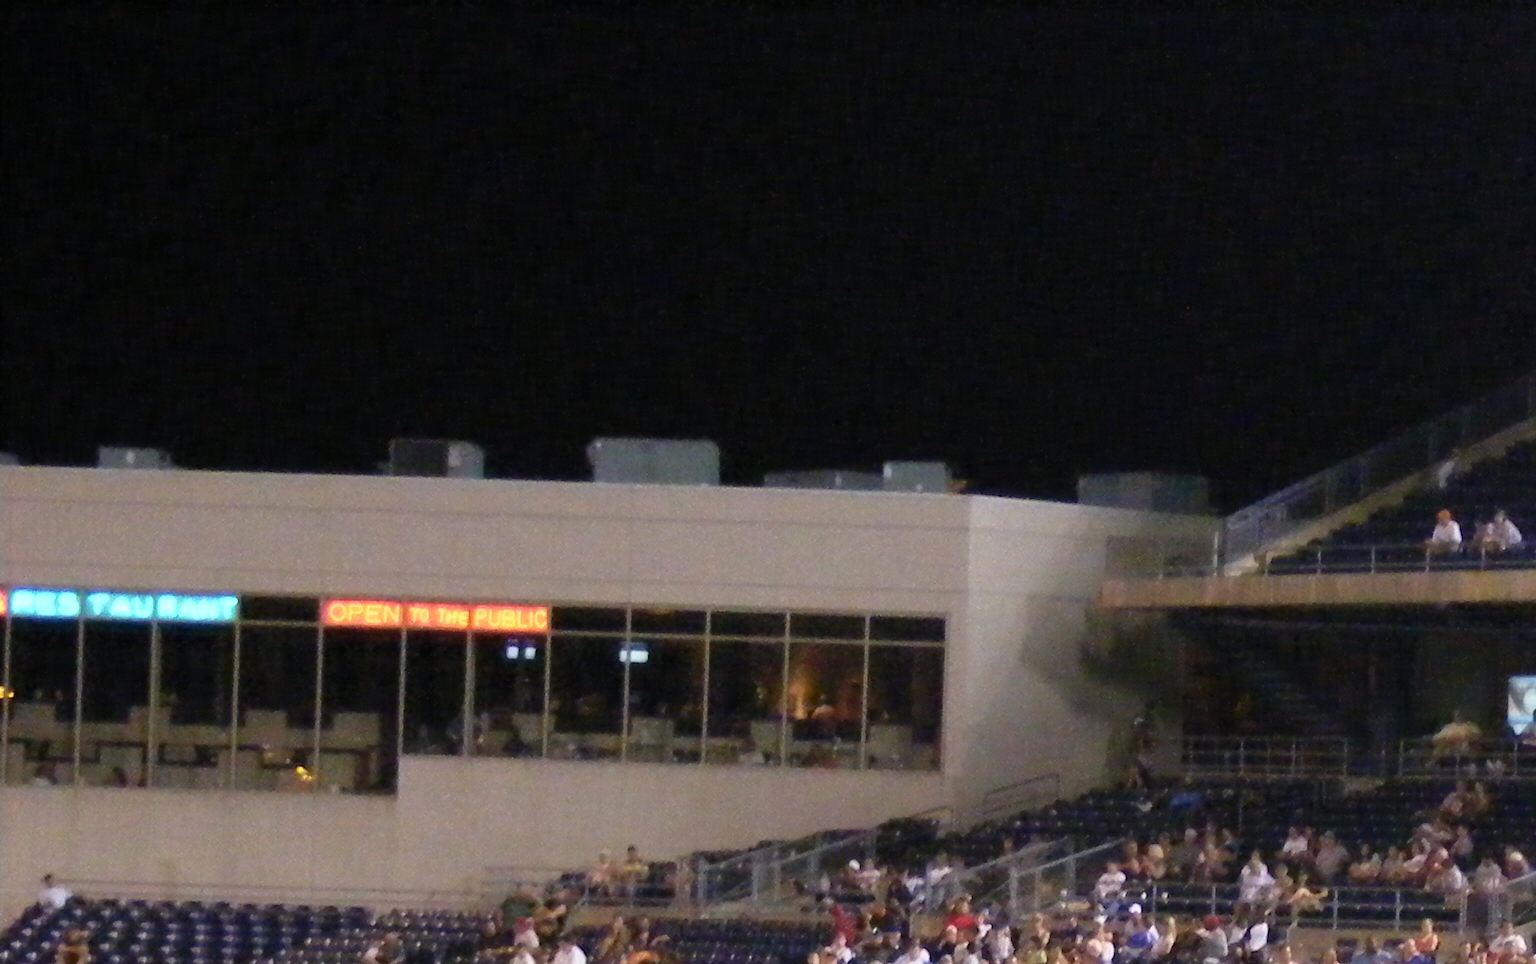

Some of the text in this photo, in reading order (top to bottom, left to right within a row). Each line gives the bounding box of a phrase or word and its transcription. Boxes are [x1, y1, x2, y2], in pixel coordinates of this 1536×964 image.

[329, 602, 547, 629] OPEN TO THE PUBLIC
